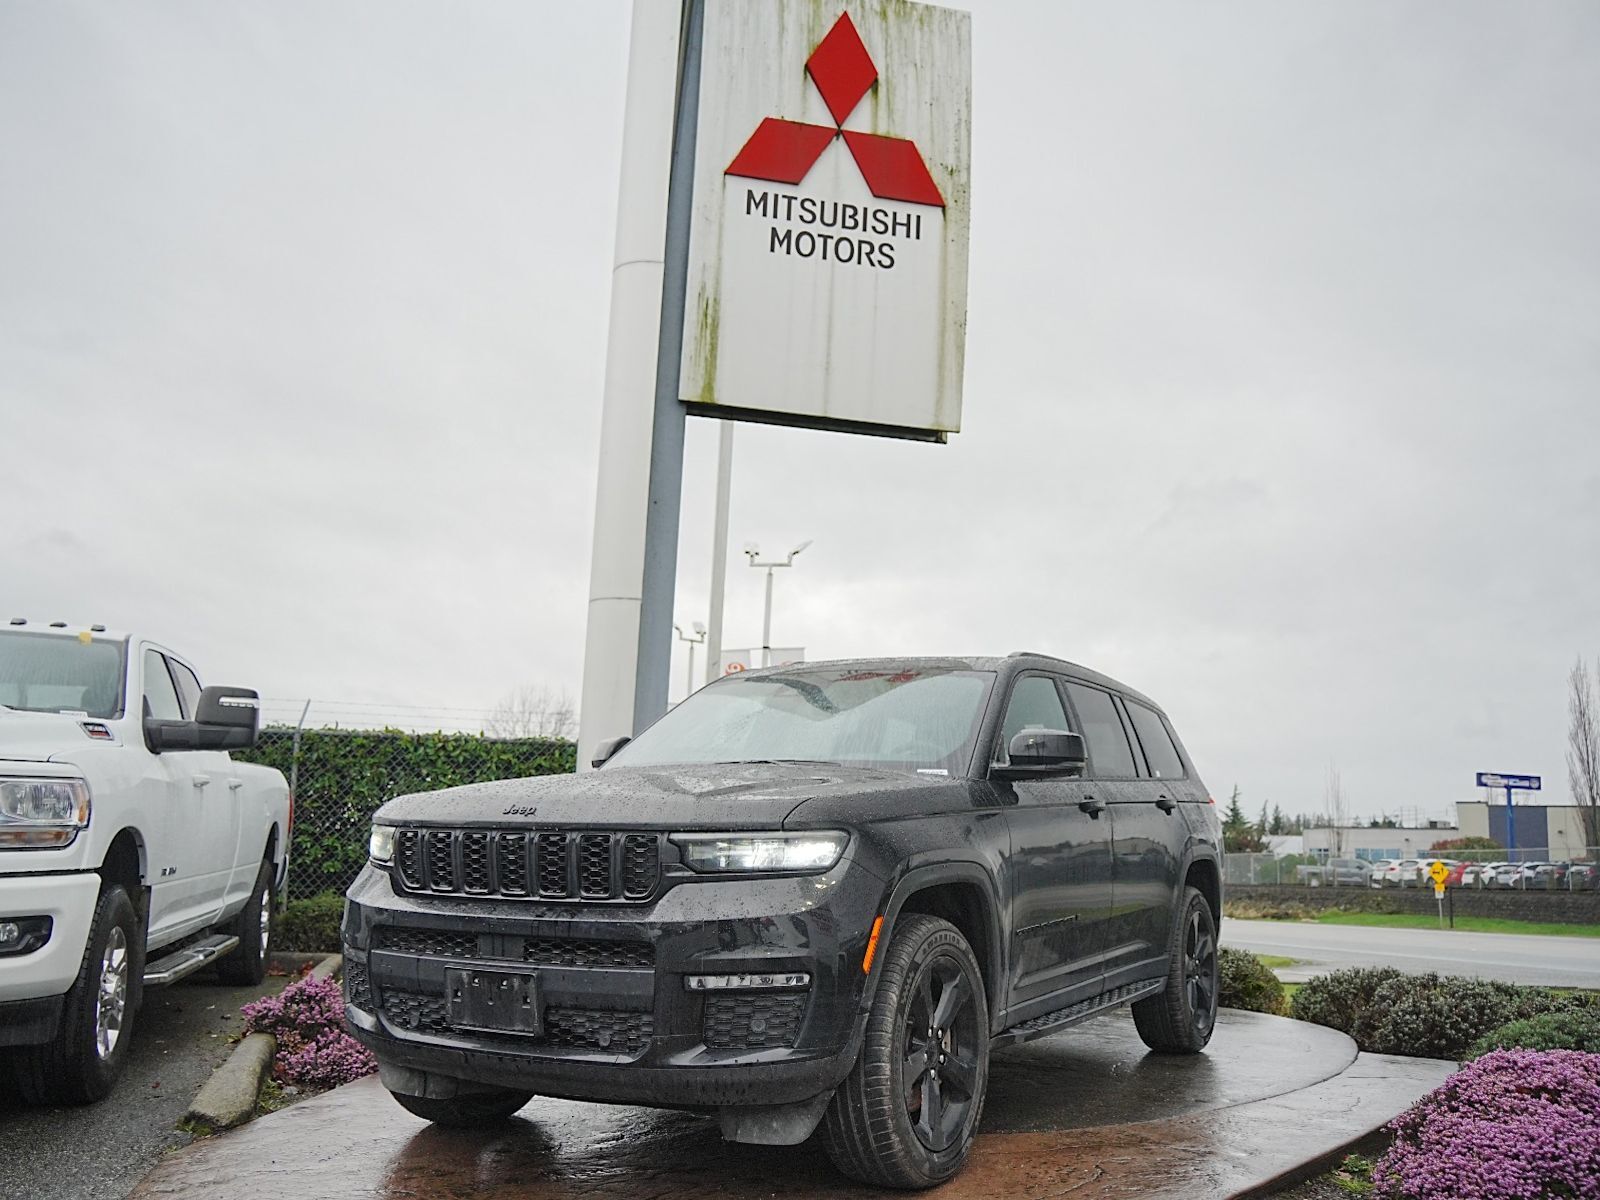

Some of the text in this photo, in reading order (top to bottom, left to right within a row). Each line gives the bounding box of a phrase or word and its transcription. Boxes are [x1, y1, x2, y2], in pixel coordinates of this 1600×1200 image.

[746, 189, 921, 240] MITSUBISHI
[769, 226, 895, 269] MOTORS
[502, 804, 537, 817] Jeep
